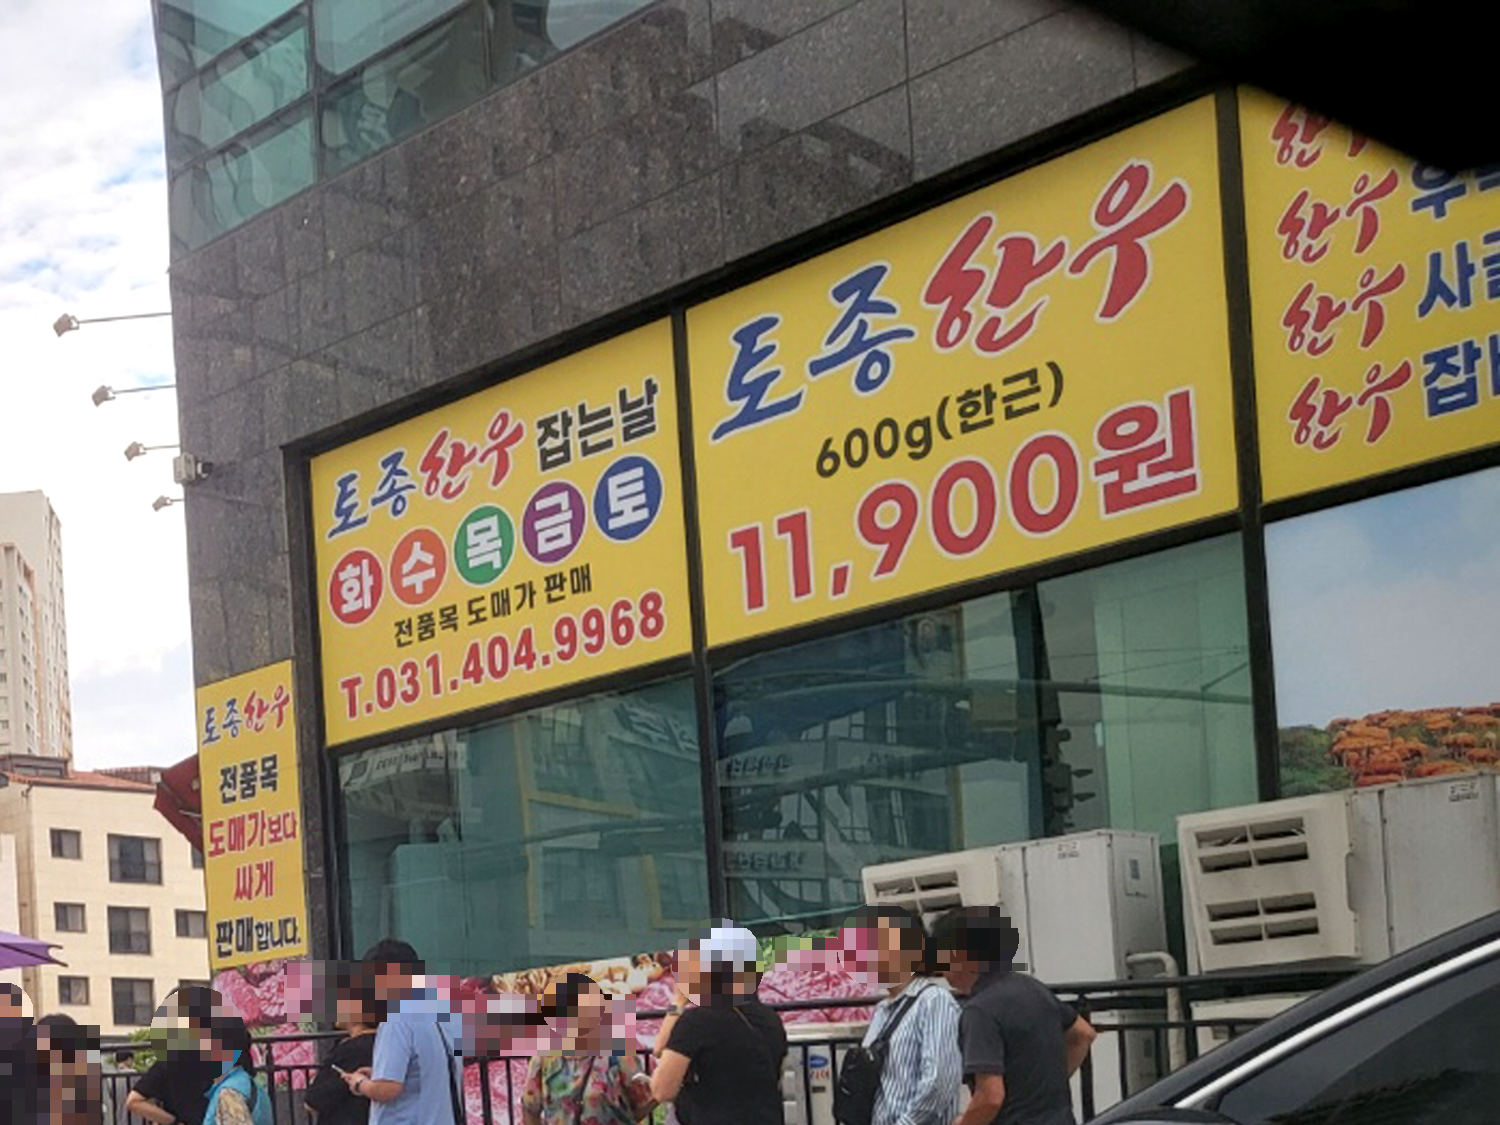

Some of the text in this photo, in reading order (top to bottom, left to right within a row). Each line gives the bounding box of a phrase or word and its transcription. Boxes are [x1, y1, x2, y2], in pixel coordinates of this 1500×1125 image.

[1277, 169, 1398, 263] 한우
[712, 163, 1188, 442] 토종한우
[1283, 263, 1406, 355] 한우
[816, 361, 1065, 478] 600g(한근)
[1289, 334, 1500, 449] 한우 잡
[327, 378, 659, 539] 토종한우 잡는날
[731, 389, 1198, 612] 11,900원
[394, 563, 593, 648] 전품목 도매가 판매
[340, 591, 664, 719] T.031.404.9968
[202, 684, 290, 745] 토종한우
[219, 754, 278, 804] 전품목
[208, 810, 297, 857] 도매가보다
[234, 860, 275, 901] 싸게
[215, 916, 301, 959] 판매합니다.
